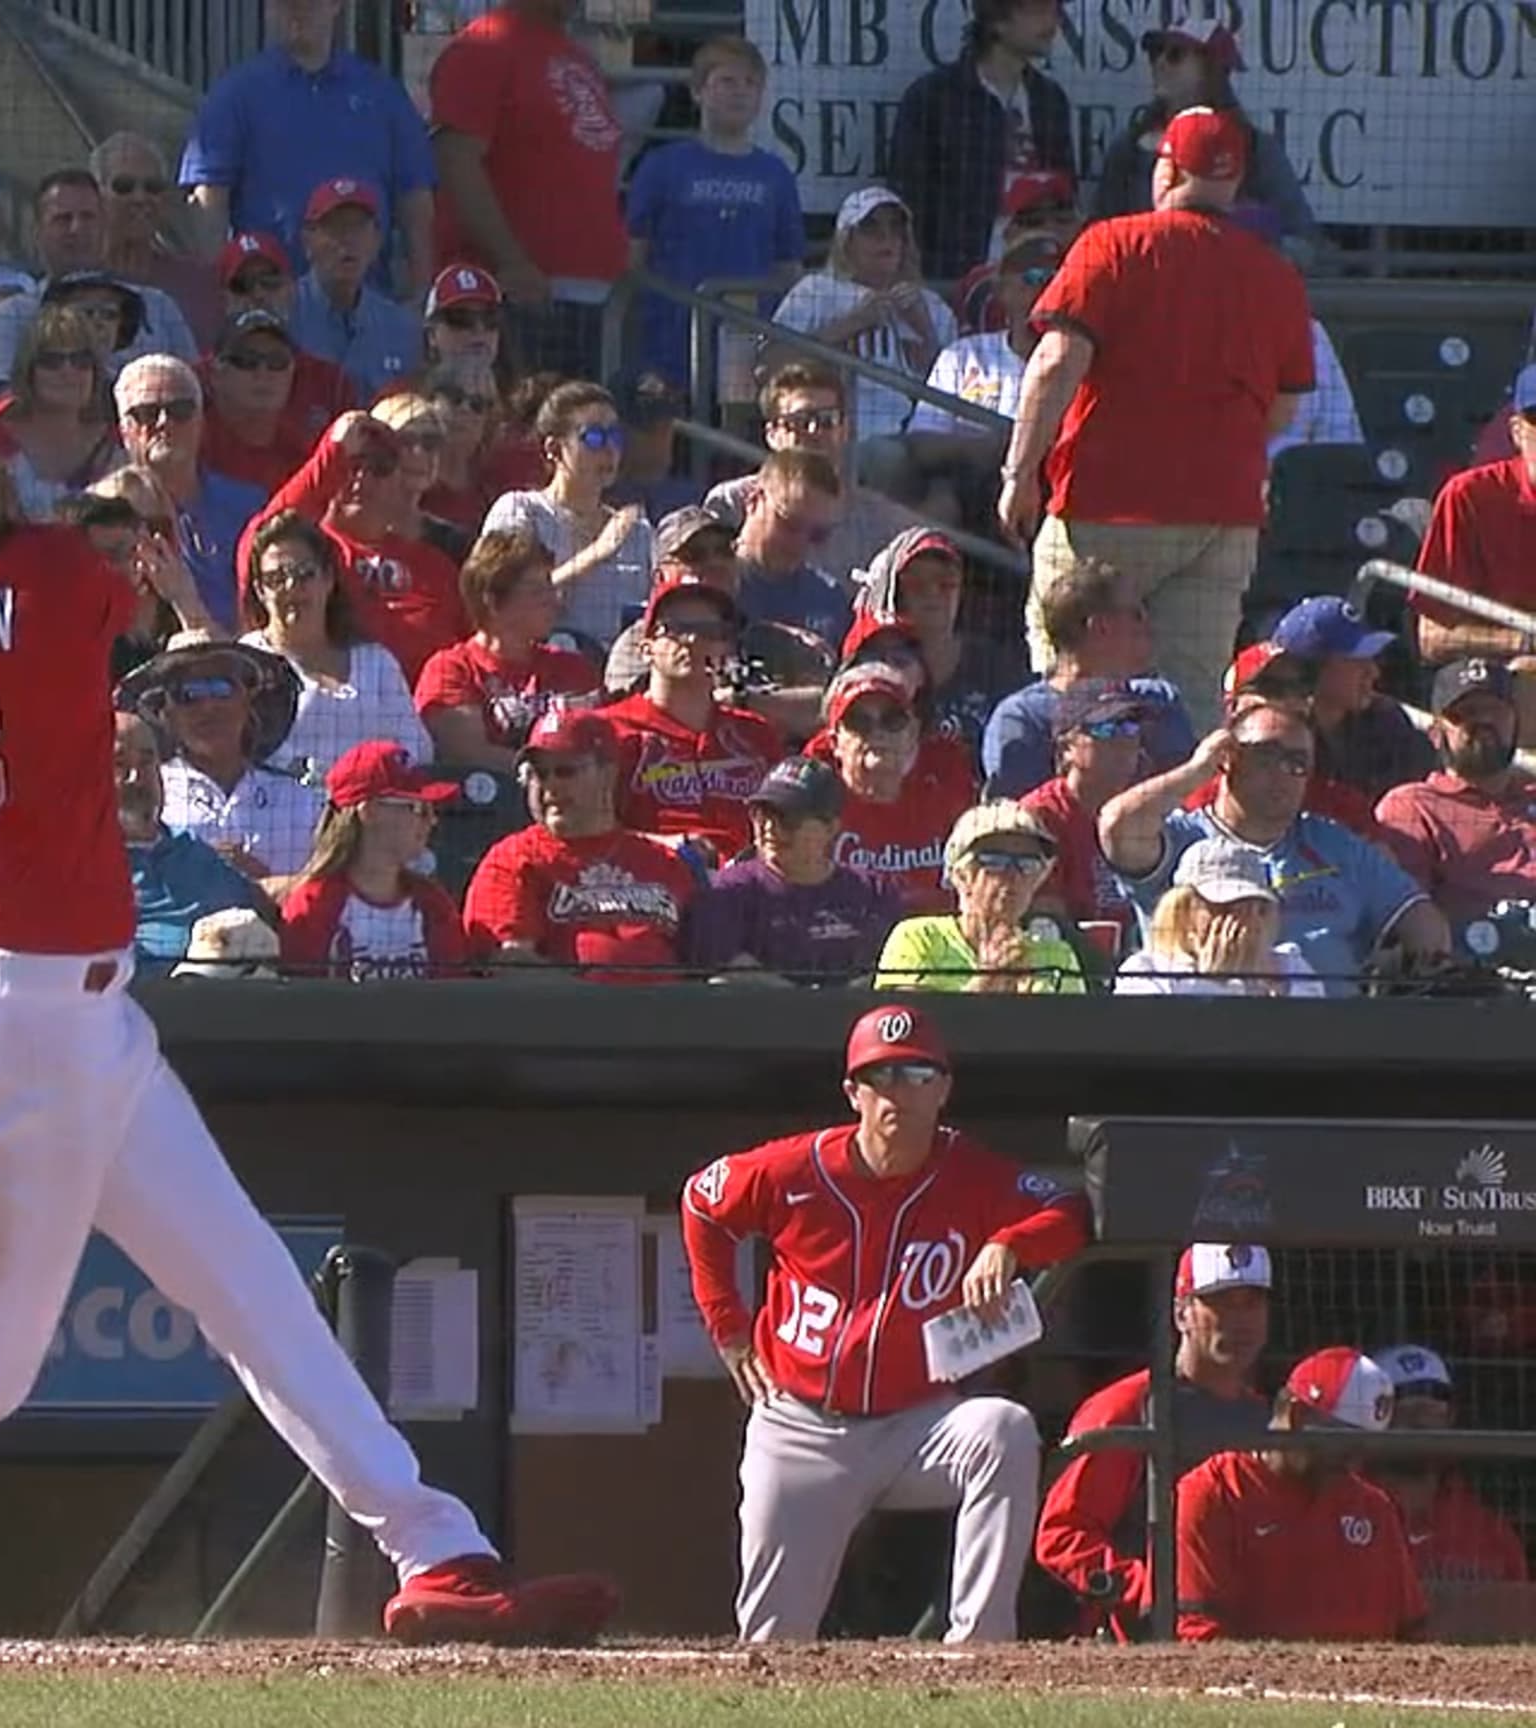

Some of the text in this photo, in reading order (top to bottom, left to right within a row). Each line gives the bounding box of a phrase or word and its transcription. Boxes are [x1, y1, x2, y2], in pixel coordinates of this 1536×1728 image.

[772, 0, 889, 67] MB
[833, 831, 945, 872] Cardinal
[876, 1010, 913, 1043] W
[1365, 1186, 1424, 1209] BB&T
[901, 1226, 965, 1310] W
[776, 1279, 840, 1357] 12
